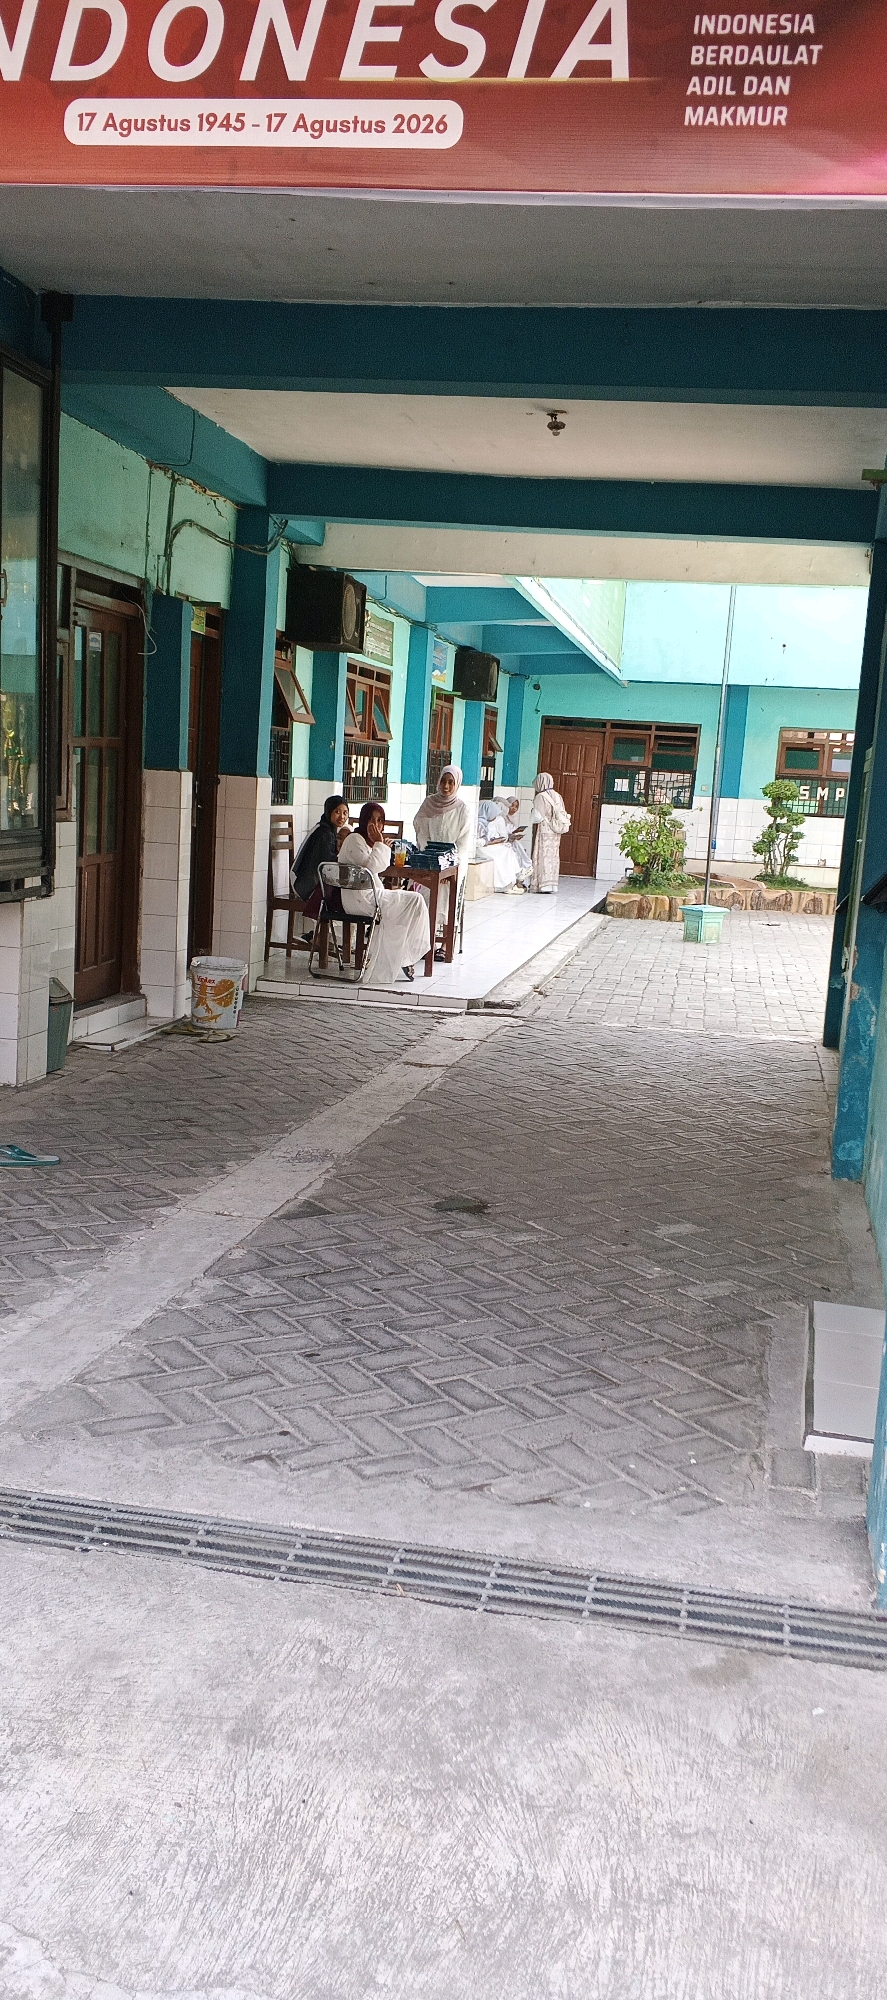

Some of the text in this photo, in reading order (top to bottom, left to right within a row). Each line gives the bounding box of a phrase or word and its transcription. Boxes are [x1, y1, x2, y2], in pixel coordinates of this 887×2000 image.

[693, 14, 815, 35] INDONESIA
[690, 45, 823, 65] BERDAULAT
[686, 76, 791, 96] ADIL DAN
[77, 112, 97, 132] 17
[102, 112, 191, 138] Agustus
[197, 112, 246, 133] 1945
[265, 112, 288, 133] 17
[292, 113, 386, 139] Agustus
[392, 113, 448, 135] 2026
[684, 106, 788, 126] MAKMUR
[799, 785, 845, 801] SMP
